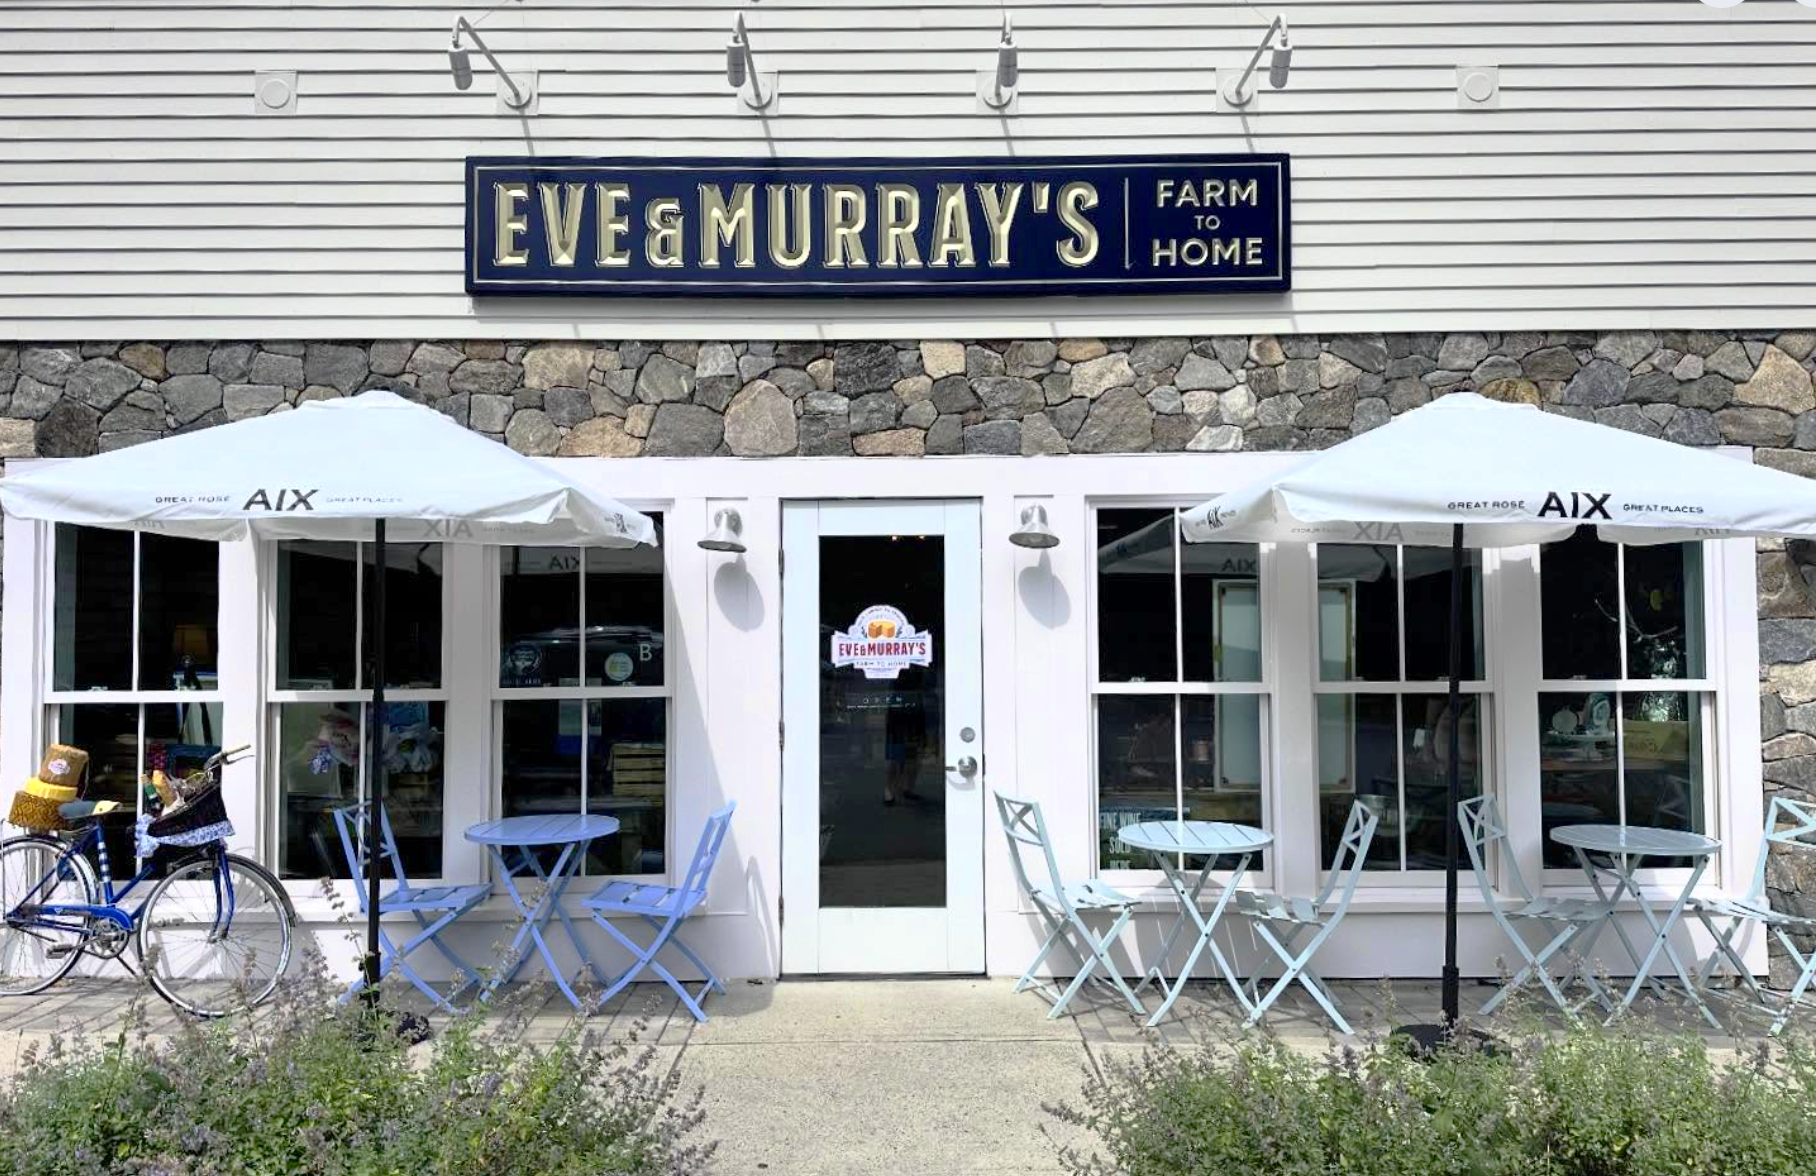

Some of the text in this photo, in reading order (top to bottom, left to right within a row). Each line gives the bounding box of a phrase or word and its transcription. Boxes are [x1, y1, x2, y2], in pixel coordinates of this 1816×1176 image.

[1157, 179, 1258, 208] FARM
[1194, 215, 1221, 230] TO
[1152, 237, 1263, 266] HOME
[242, 488, 319, 511] AIX
[1447, 501, 1488, 510] GREAT
[1537, 491, 1613, 520] AIX
[1623, 503, 1659, 512] GREAT
[1661, 505, 1704, 514] PLACES
